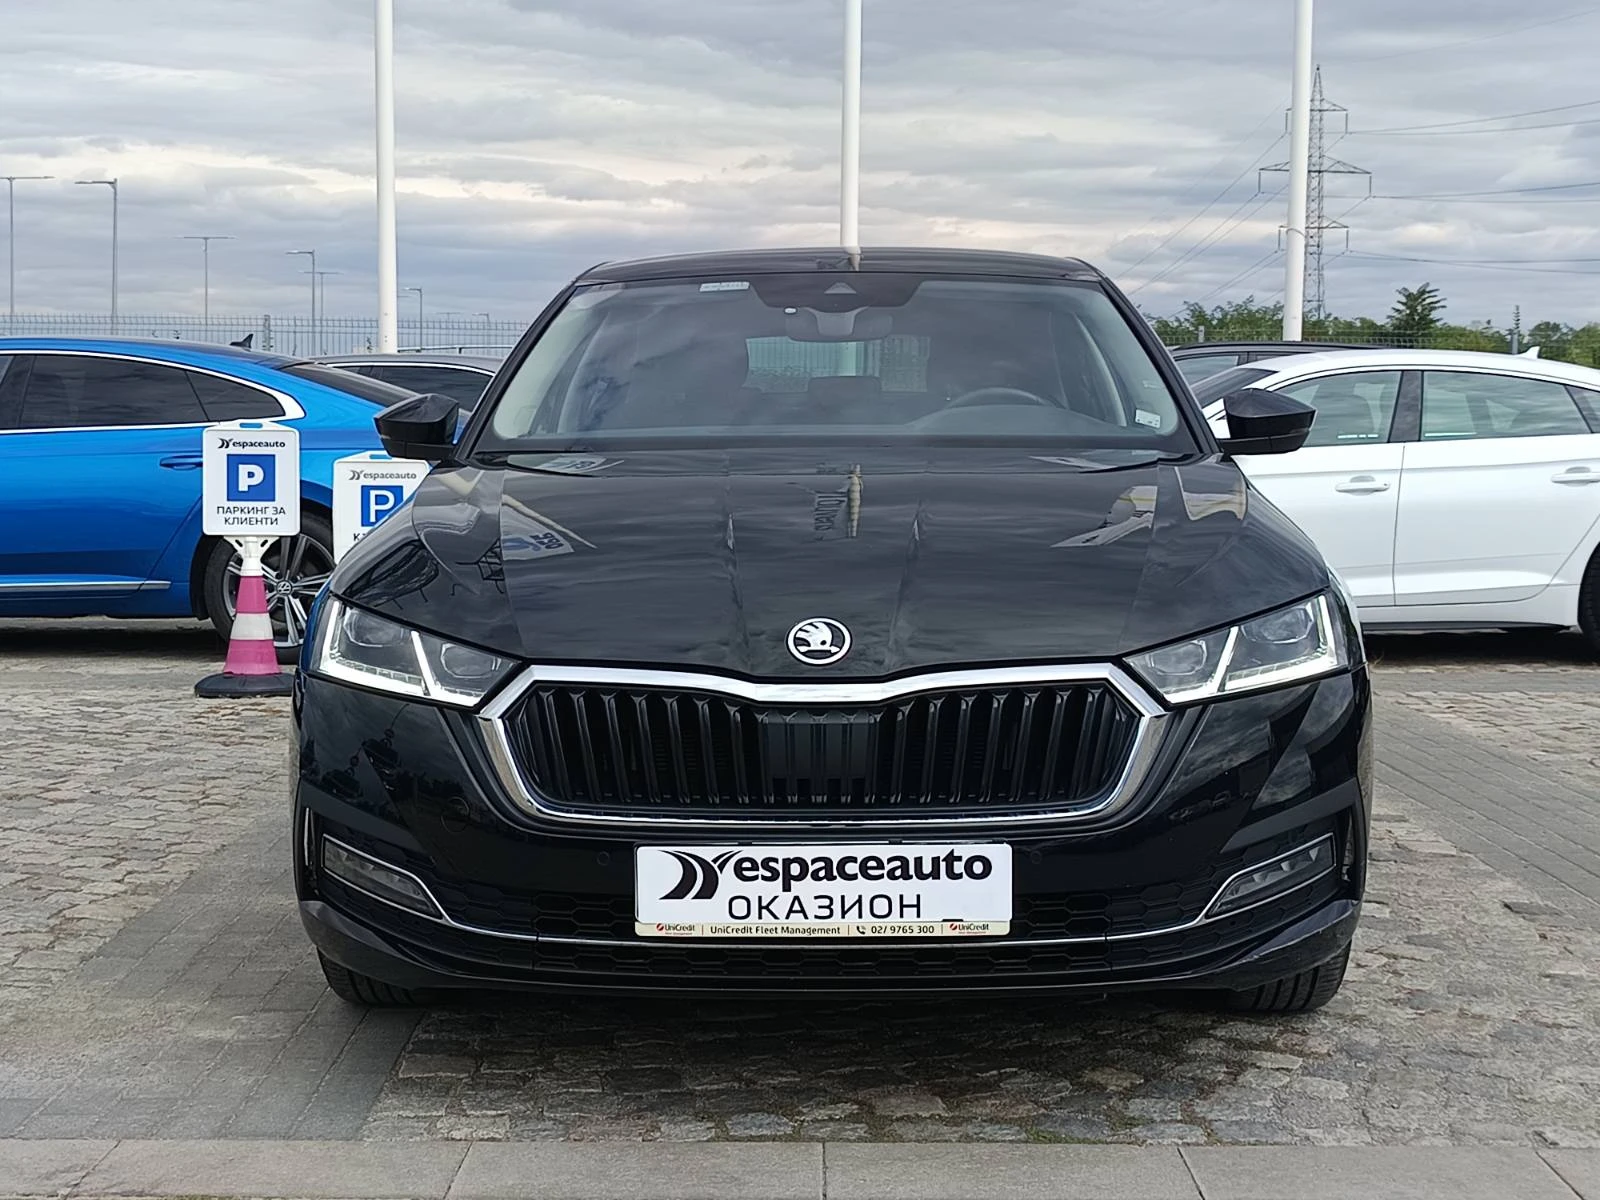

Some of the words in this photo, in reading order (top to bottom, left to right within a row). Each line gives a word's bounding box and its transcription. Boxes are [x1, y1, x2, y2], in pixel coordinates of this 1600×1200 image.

[232, 439, 286, 449] espaceauto
[238, 464, 264, 491] P
[363, 471, 417, 481] espaceauto
[216, 506, 270, 516] ПАРКИНГ
[271, 506, 286, 516] ЗА
[369, 490, 395, 523] P
[224, 517, 279, 526] КЛИЕНТИ
[733, 849, 992, 892] espaceauto
[728, 893, 921, 920] ОКАЗИОН
[710, 925, 753, 934] UniCredit
[755, 925, 778, 934] Fleet
[780, 925, 841, 936] Management
[870, 925, 887, 934] 02/
[889, 925, 914, 934] 9765
[917, 925, 935, 934] 300
